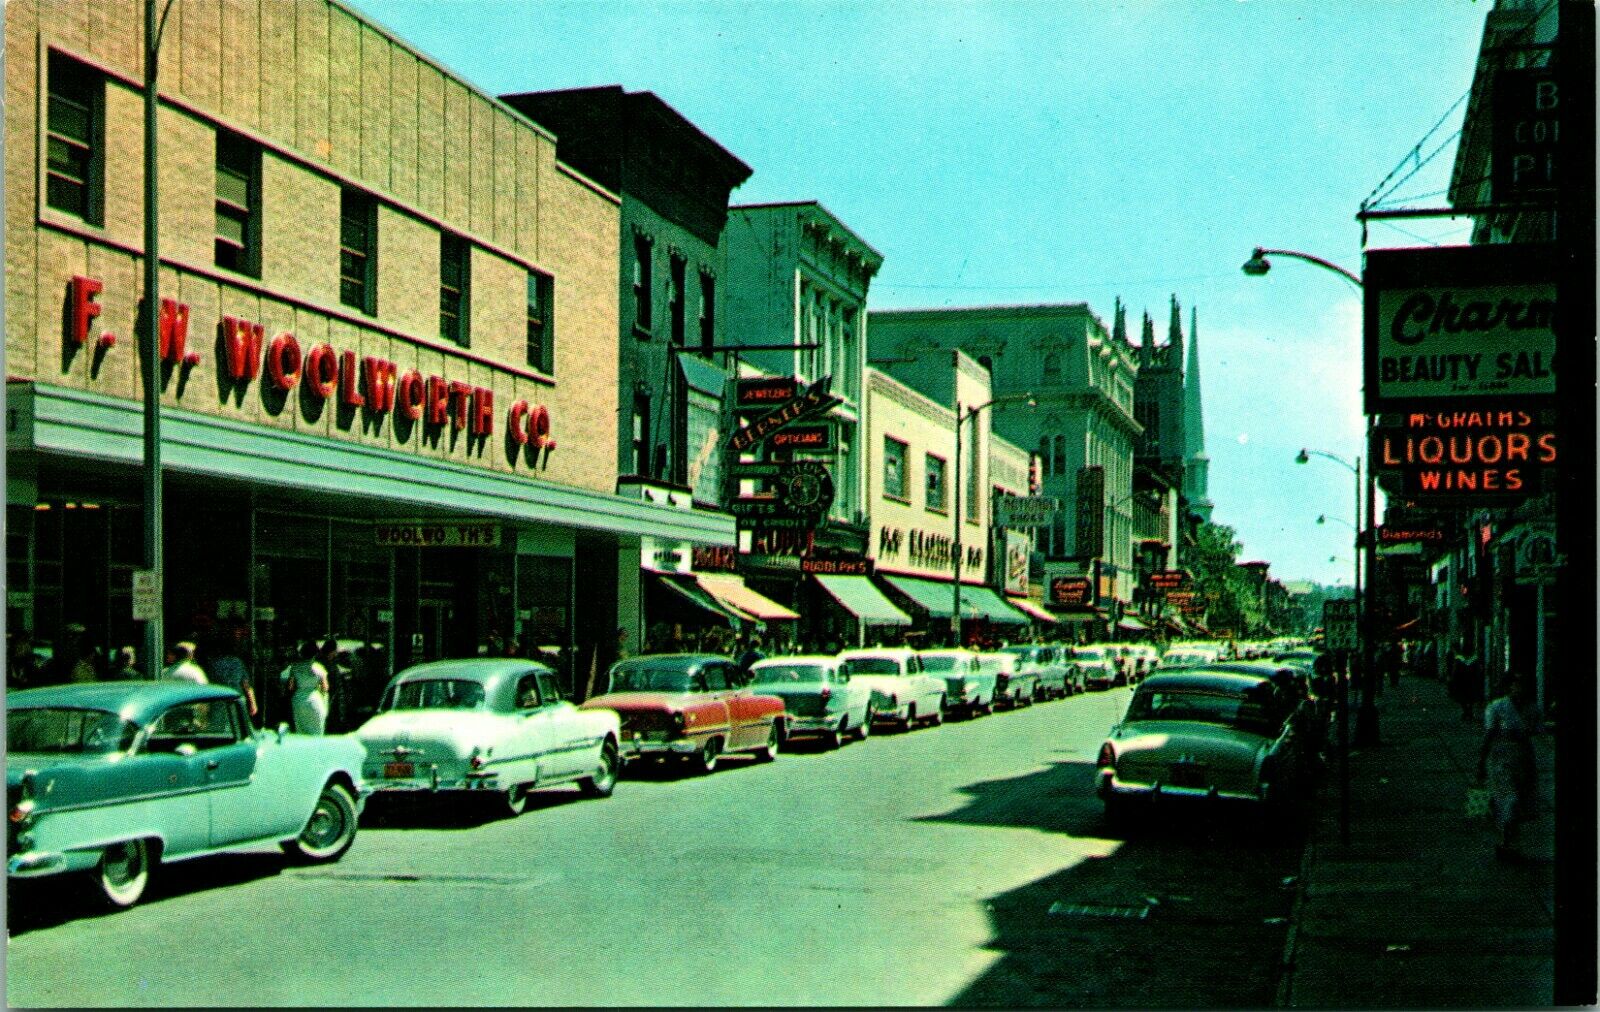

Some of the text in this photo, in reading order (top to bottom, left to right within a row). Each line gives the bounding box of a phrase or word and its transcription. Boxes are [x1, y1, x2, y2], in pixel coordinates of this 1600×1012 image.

[71, 273, 116, 344] F.
[223, 315, 495, 436] WOOLWORTH
[511, 399, 558, 449] CO.
[1381, 351, 1557, 382] BEAUTY SAL
[743, 387, 793, 402] JEWELERS
[773, 432, 823, 447] OPTICIANS
[1383, 433, 1558, 465] LIQUORS
[1419, 469, 1523, 491] WINES
[802, 558, 867, 573] RUDOLPH'S
